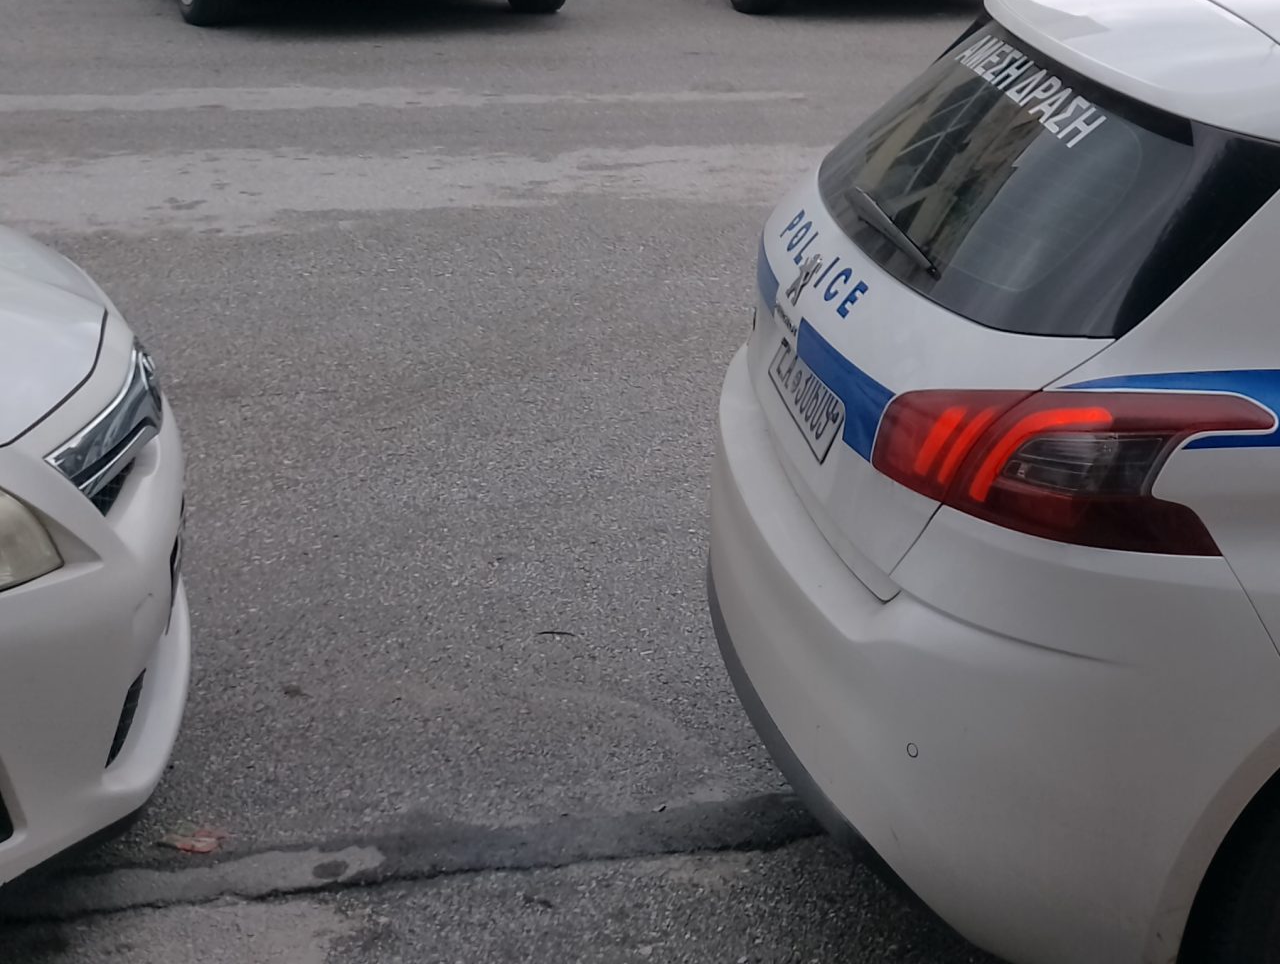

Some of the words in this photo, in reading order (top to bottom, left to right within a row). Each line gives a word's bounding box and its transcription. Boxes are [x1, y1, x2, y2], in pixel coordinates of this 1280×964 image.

[954, 34, 1035, 90] ΑΜΕΣΗ
[1005, 68, 1107, 149] ΔΡΑΣΗ
[779, 209, 869, 319] POLICE
